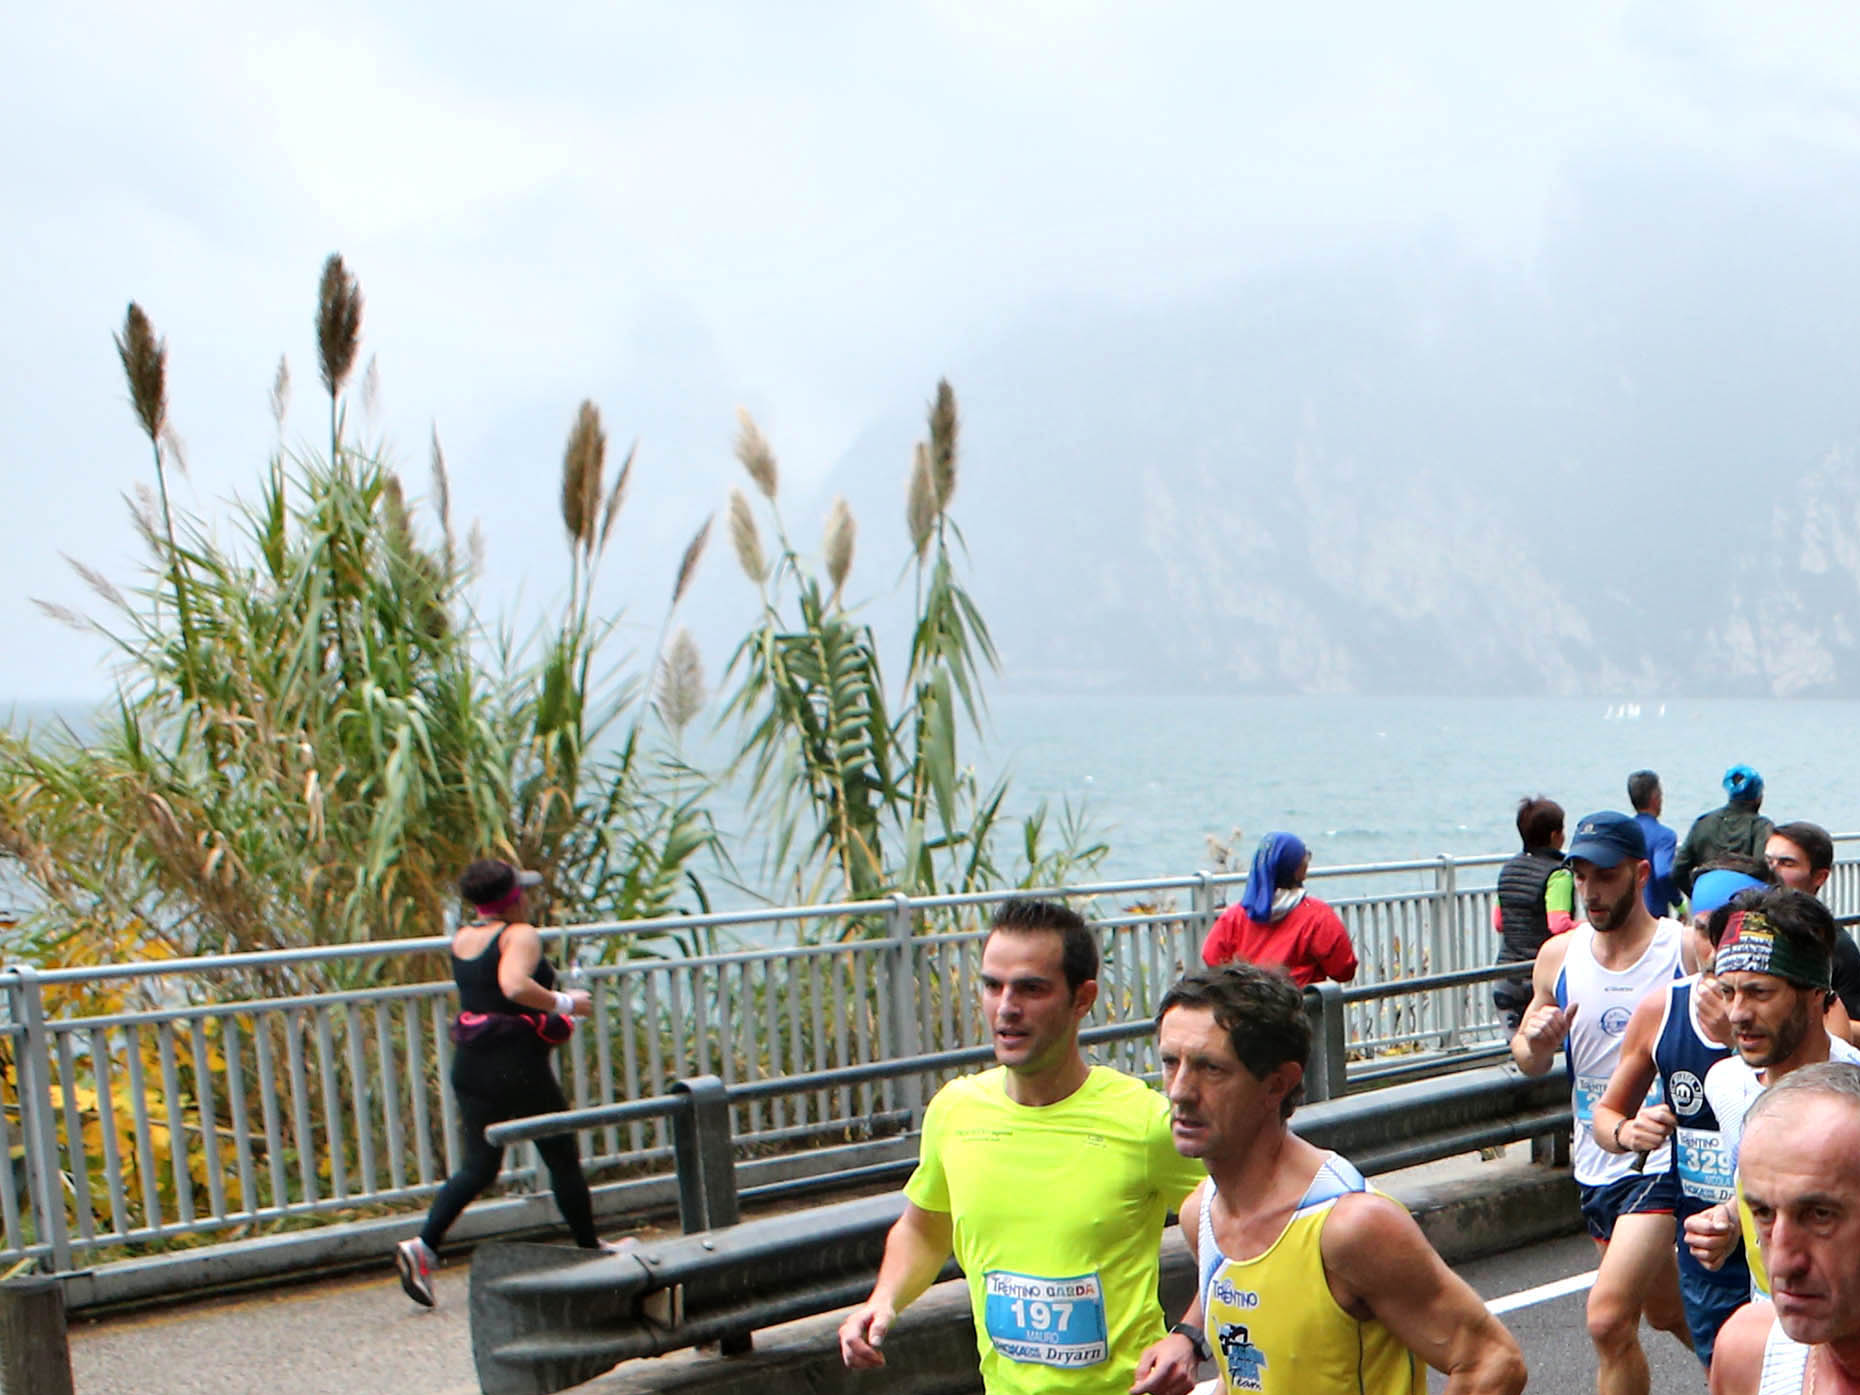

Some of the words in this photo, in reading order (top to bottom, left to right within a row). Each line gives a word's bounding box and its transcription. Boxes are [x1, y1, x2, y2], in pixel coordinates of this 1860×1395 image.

[1686, 1147, 1732, 1176] 329
[991, 1276, 1041, 1298] TRENTINO
[1046, 1283, 1096, 1298] GARDA
[1010, 1299, 1074, 1332] 197
[1046, 1347, 1102, 1364] Dryarn
